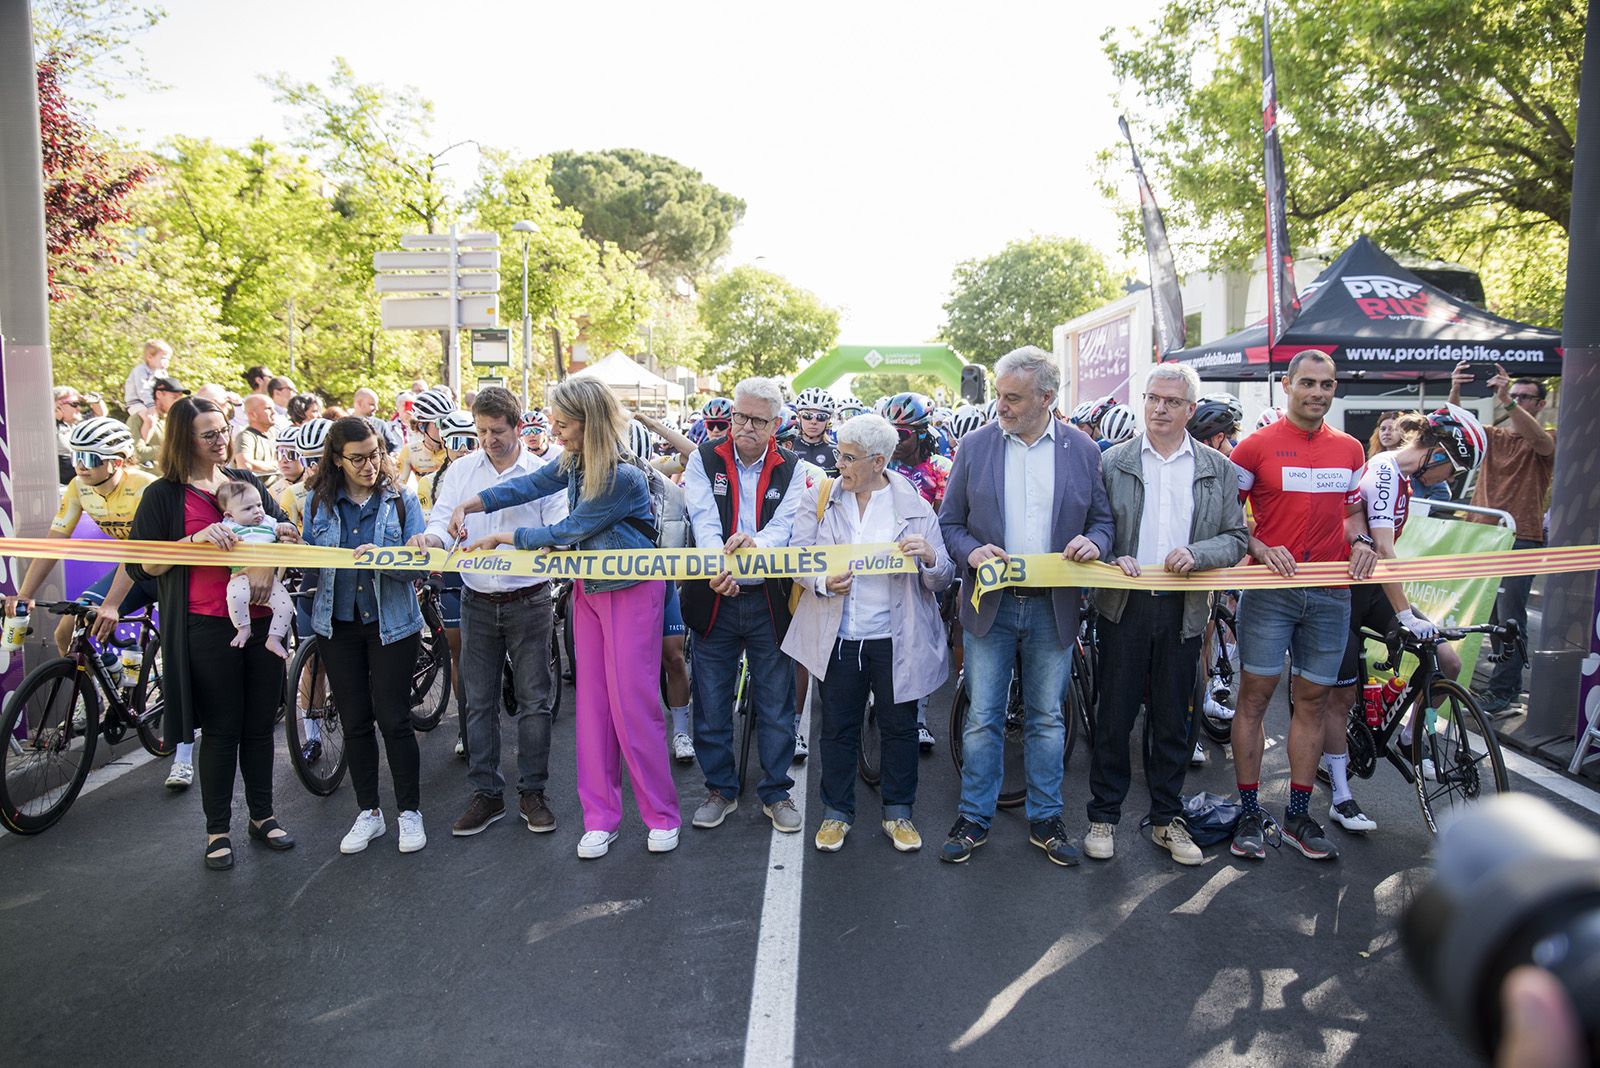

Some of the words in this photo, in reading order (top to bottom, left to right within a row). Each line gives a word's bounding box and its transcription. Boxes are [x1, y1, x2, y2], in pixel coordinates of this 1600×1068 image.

[1346, 345, 1544, 363] www.proridebike.com
[354, 550, 431, 567] 2023
[456, 557, 512, 571] reVolta
[532, 555, 598, 575] SANT
[601, 555, 681, 576] CUGAT
[736, 547, 828, 575] VALLÈS
[848, 555, 903, 571] reVolta
[976, 557, 1027, 587] 023
[1381, 686, 1413, 732] LOOK
